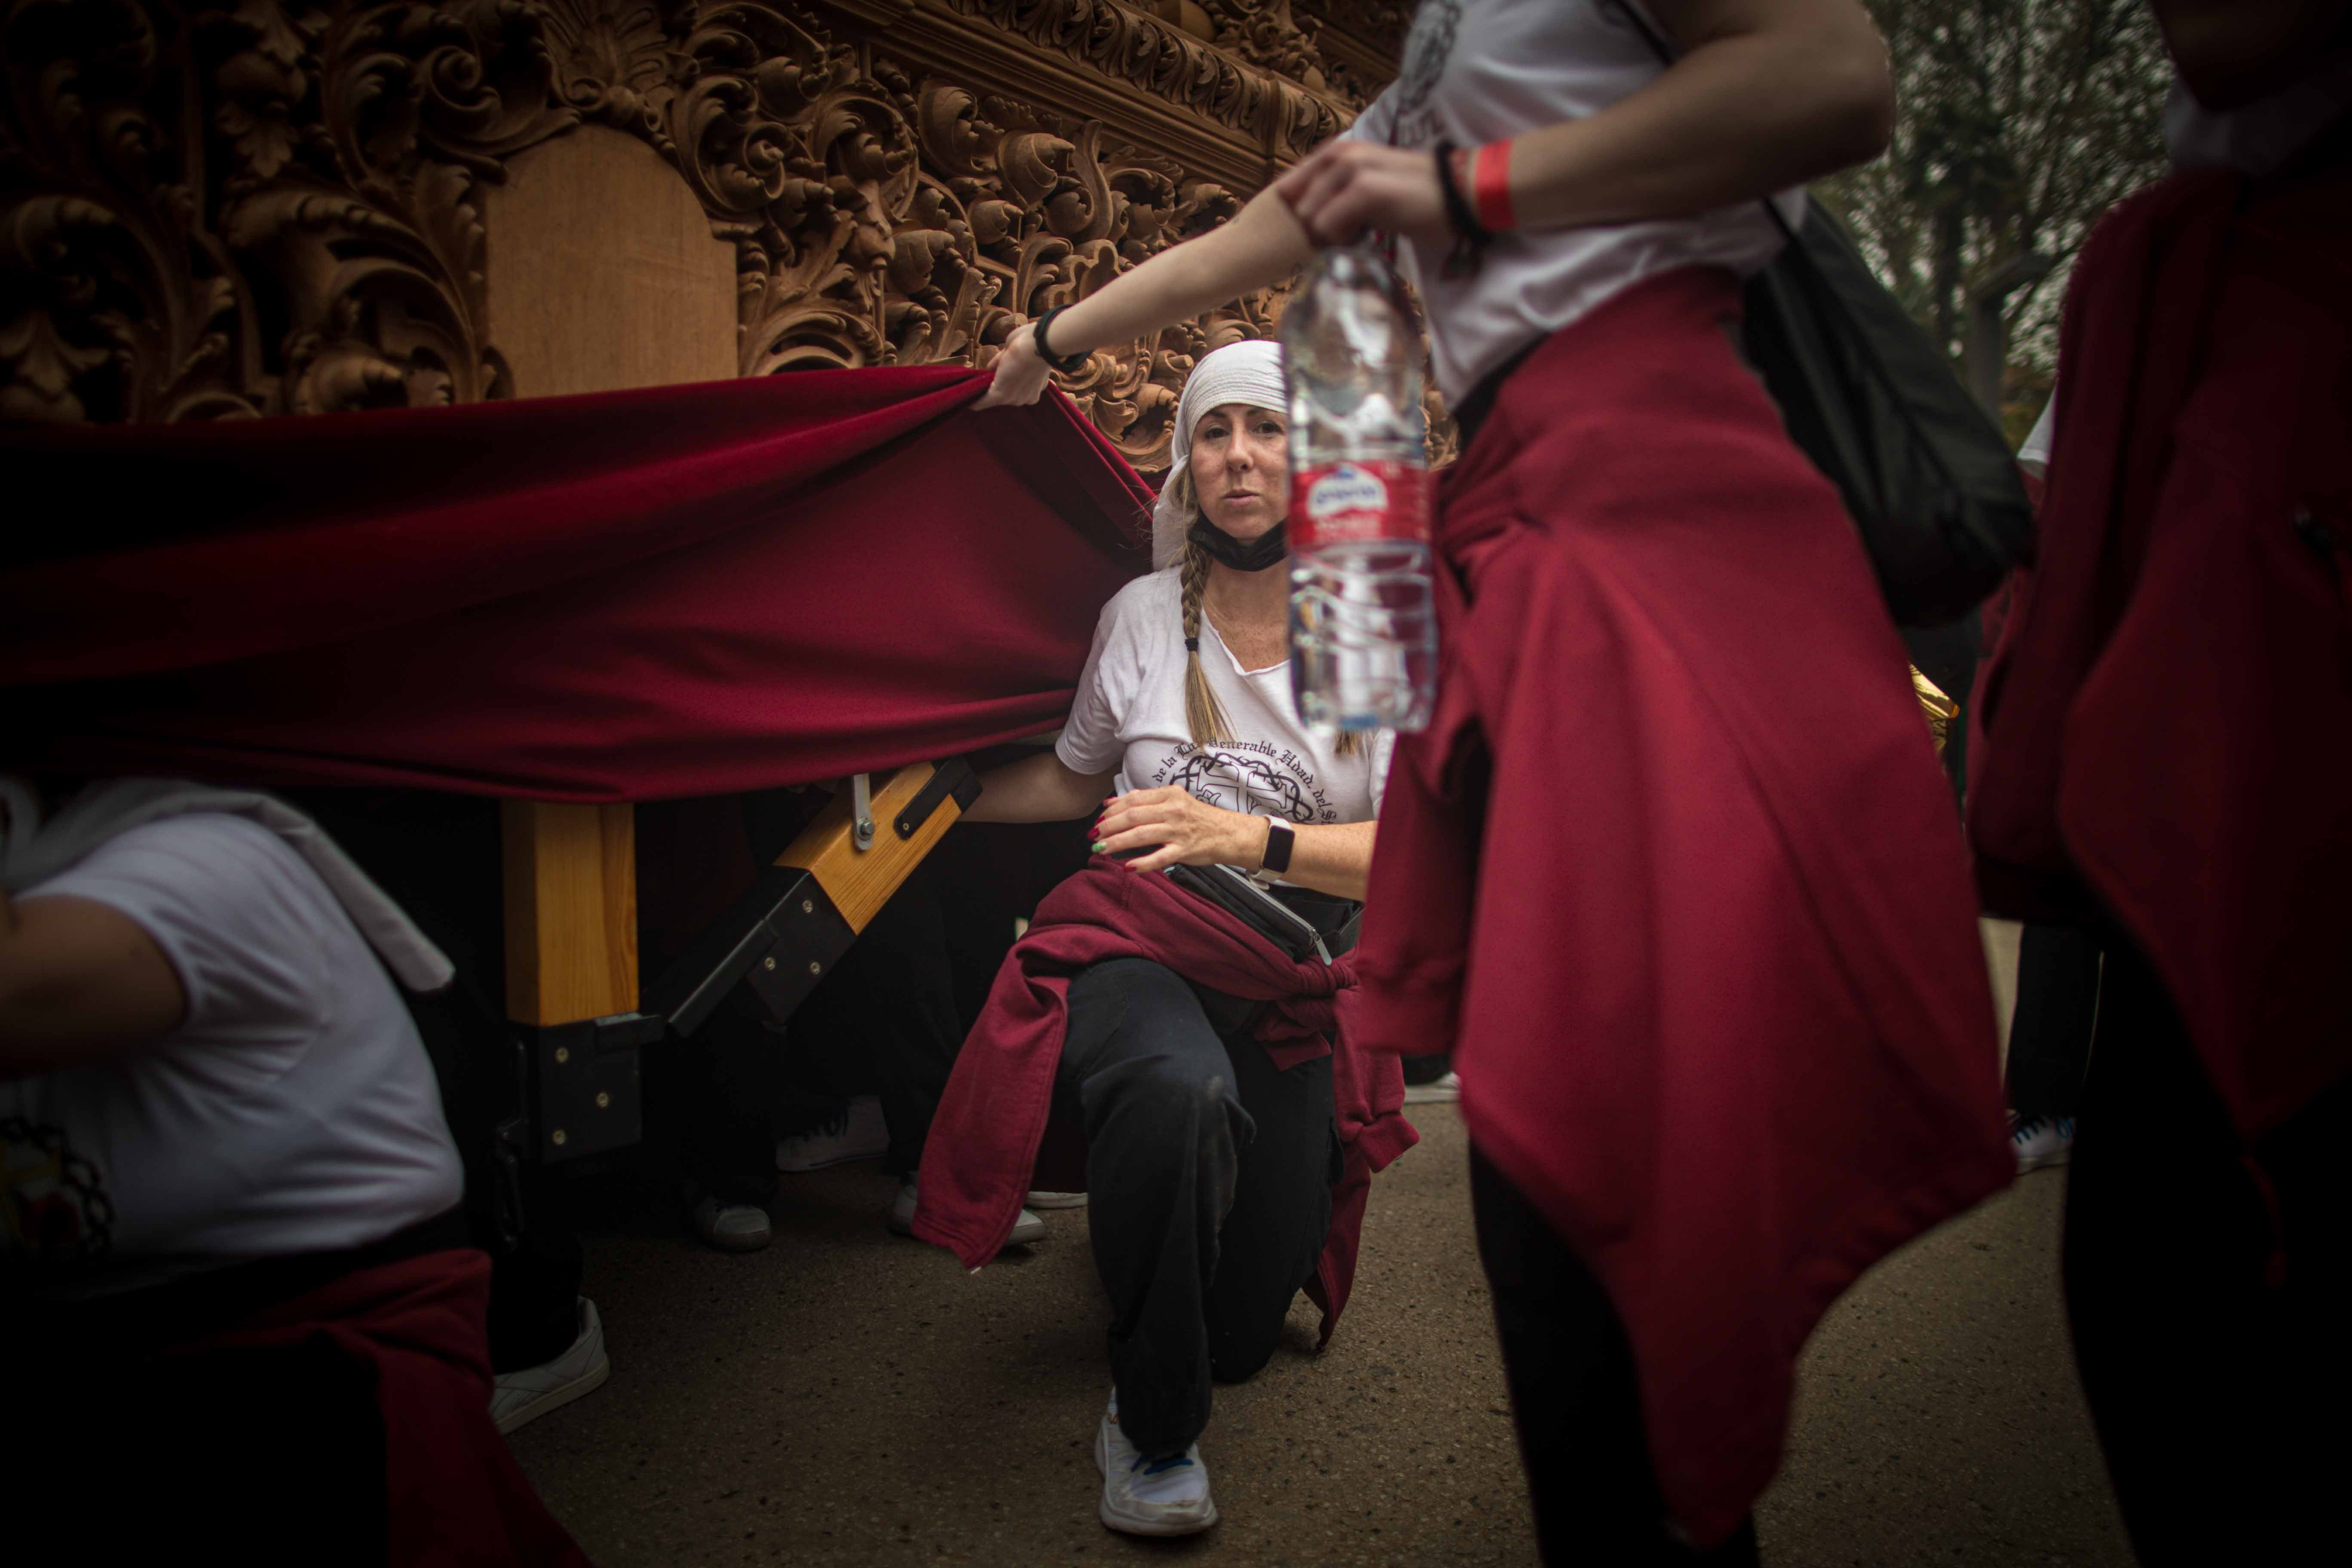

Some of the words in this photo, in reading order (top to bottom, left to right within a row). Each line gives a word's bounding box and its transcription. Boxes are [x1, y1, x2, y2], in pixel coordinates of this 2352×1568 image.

[1152, 768, 1167, 783] de
[1161, 756, 1177, 768] la
[1313, 789, 1333, 807] del
